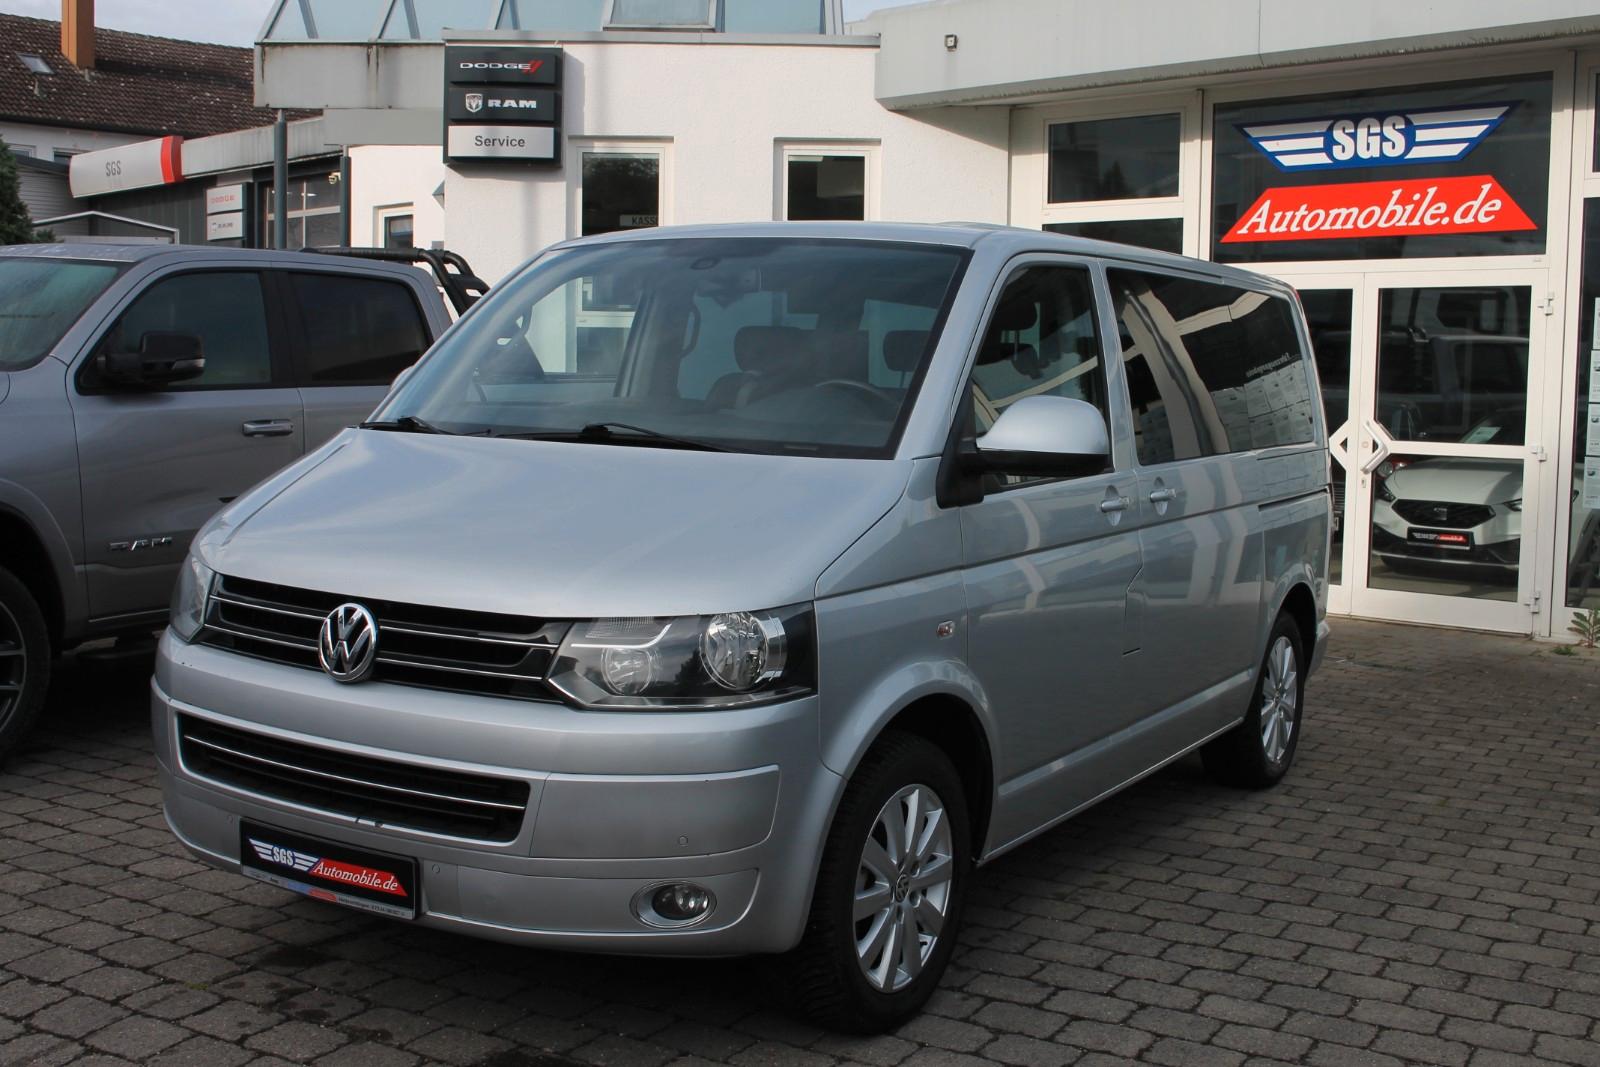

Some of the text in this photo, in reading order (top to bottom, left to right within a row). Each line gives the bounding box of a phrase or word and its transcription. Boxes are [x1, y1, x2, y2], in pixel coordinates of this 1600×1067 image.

[460, 62, 531, 70] DODGE
[487, 99, 536, 109] RAM
[474, 135, 526, 148] Service
[1331, 114, 1408, 161] SGS
[105, 160, 121, 176] SGS
[1236, 182, 1503, 235] Automobile.de
[272, 846, 294, 867] SGS
[313, 861, 399, 891] Automobile.de
